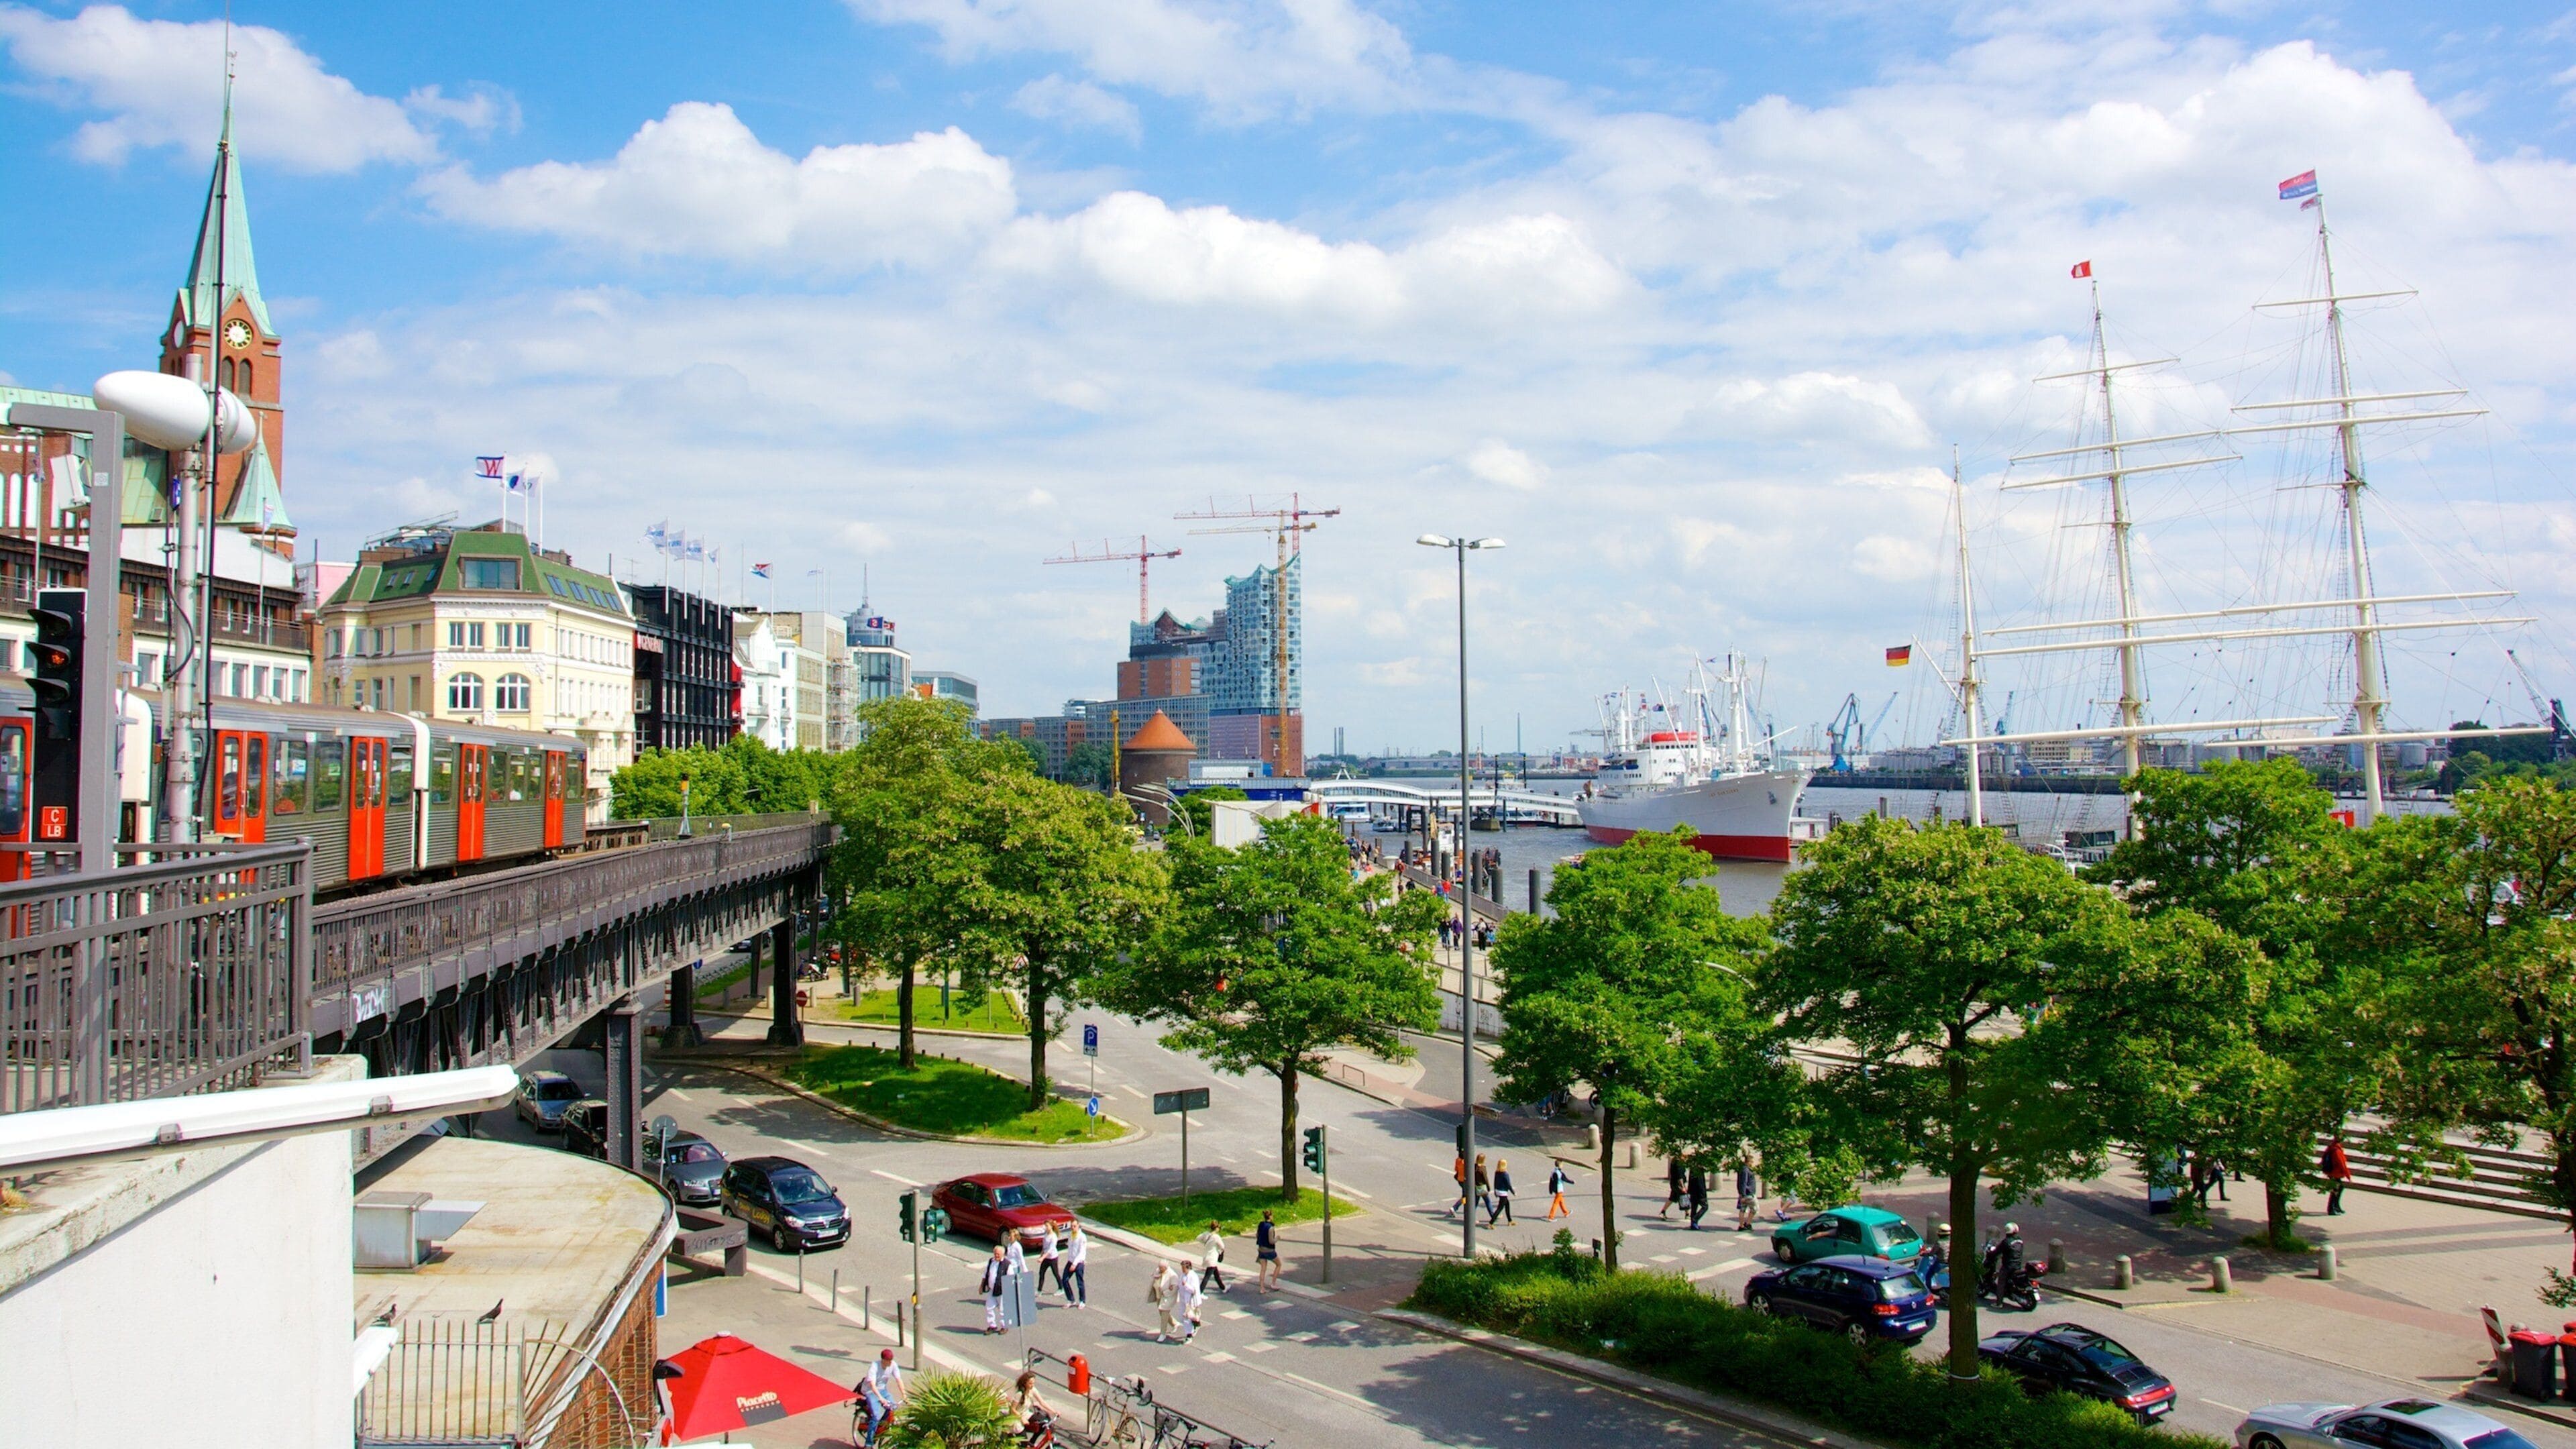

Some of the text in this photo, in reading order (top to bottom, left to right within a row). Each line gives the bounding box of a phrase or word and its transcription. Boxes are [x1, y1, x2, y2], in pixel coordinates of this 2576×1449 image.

[51, 809, 60, 823] C
[48, 825, 62, 837] LB
[1087, 1031, 1094, 1043] P
